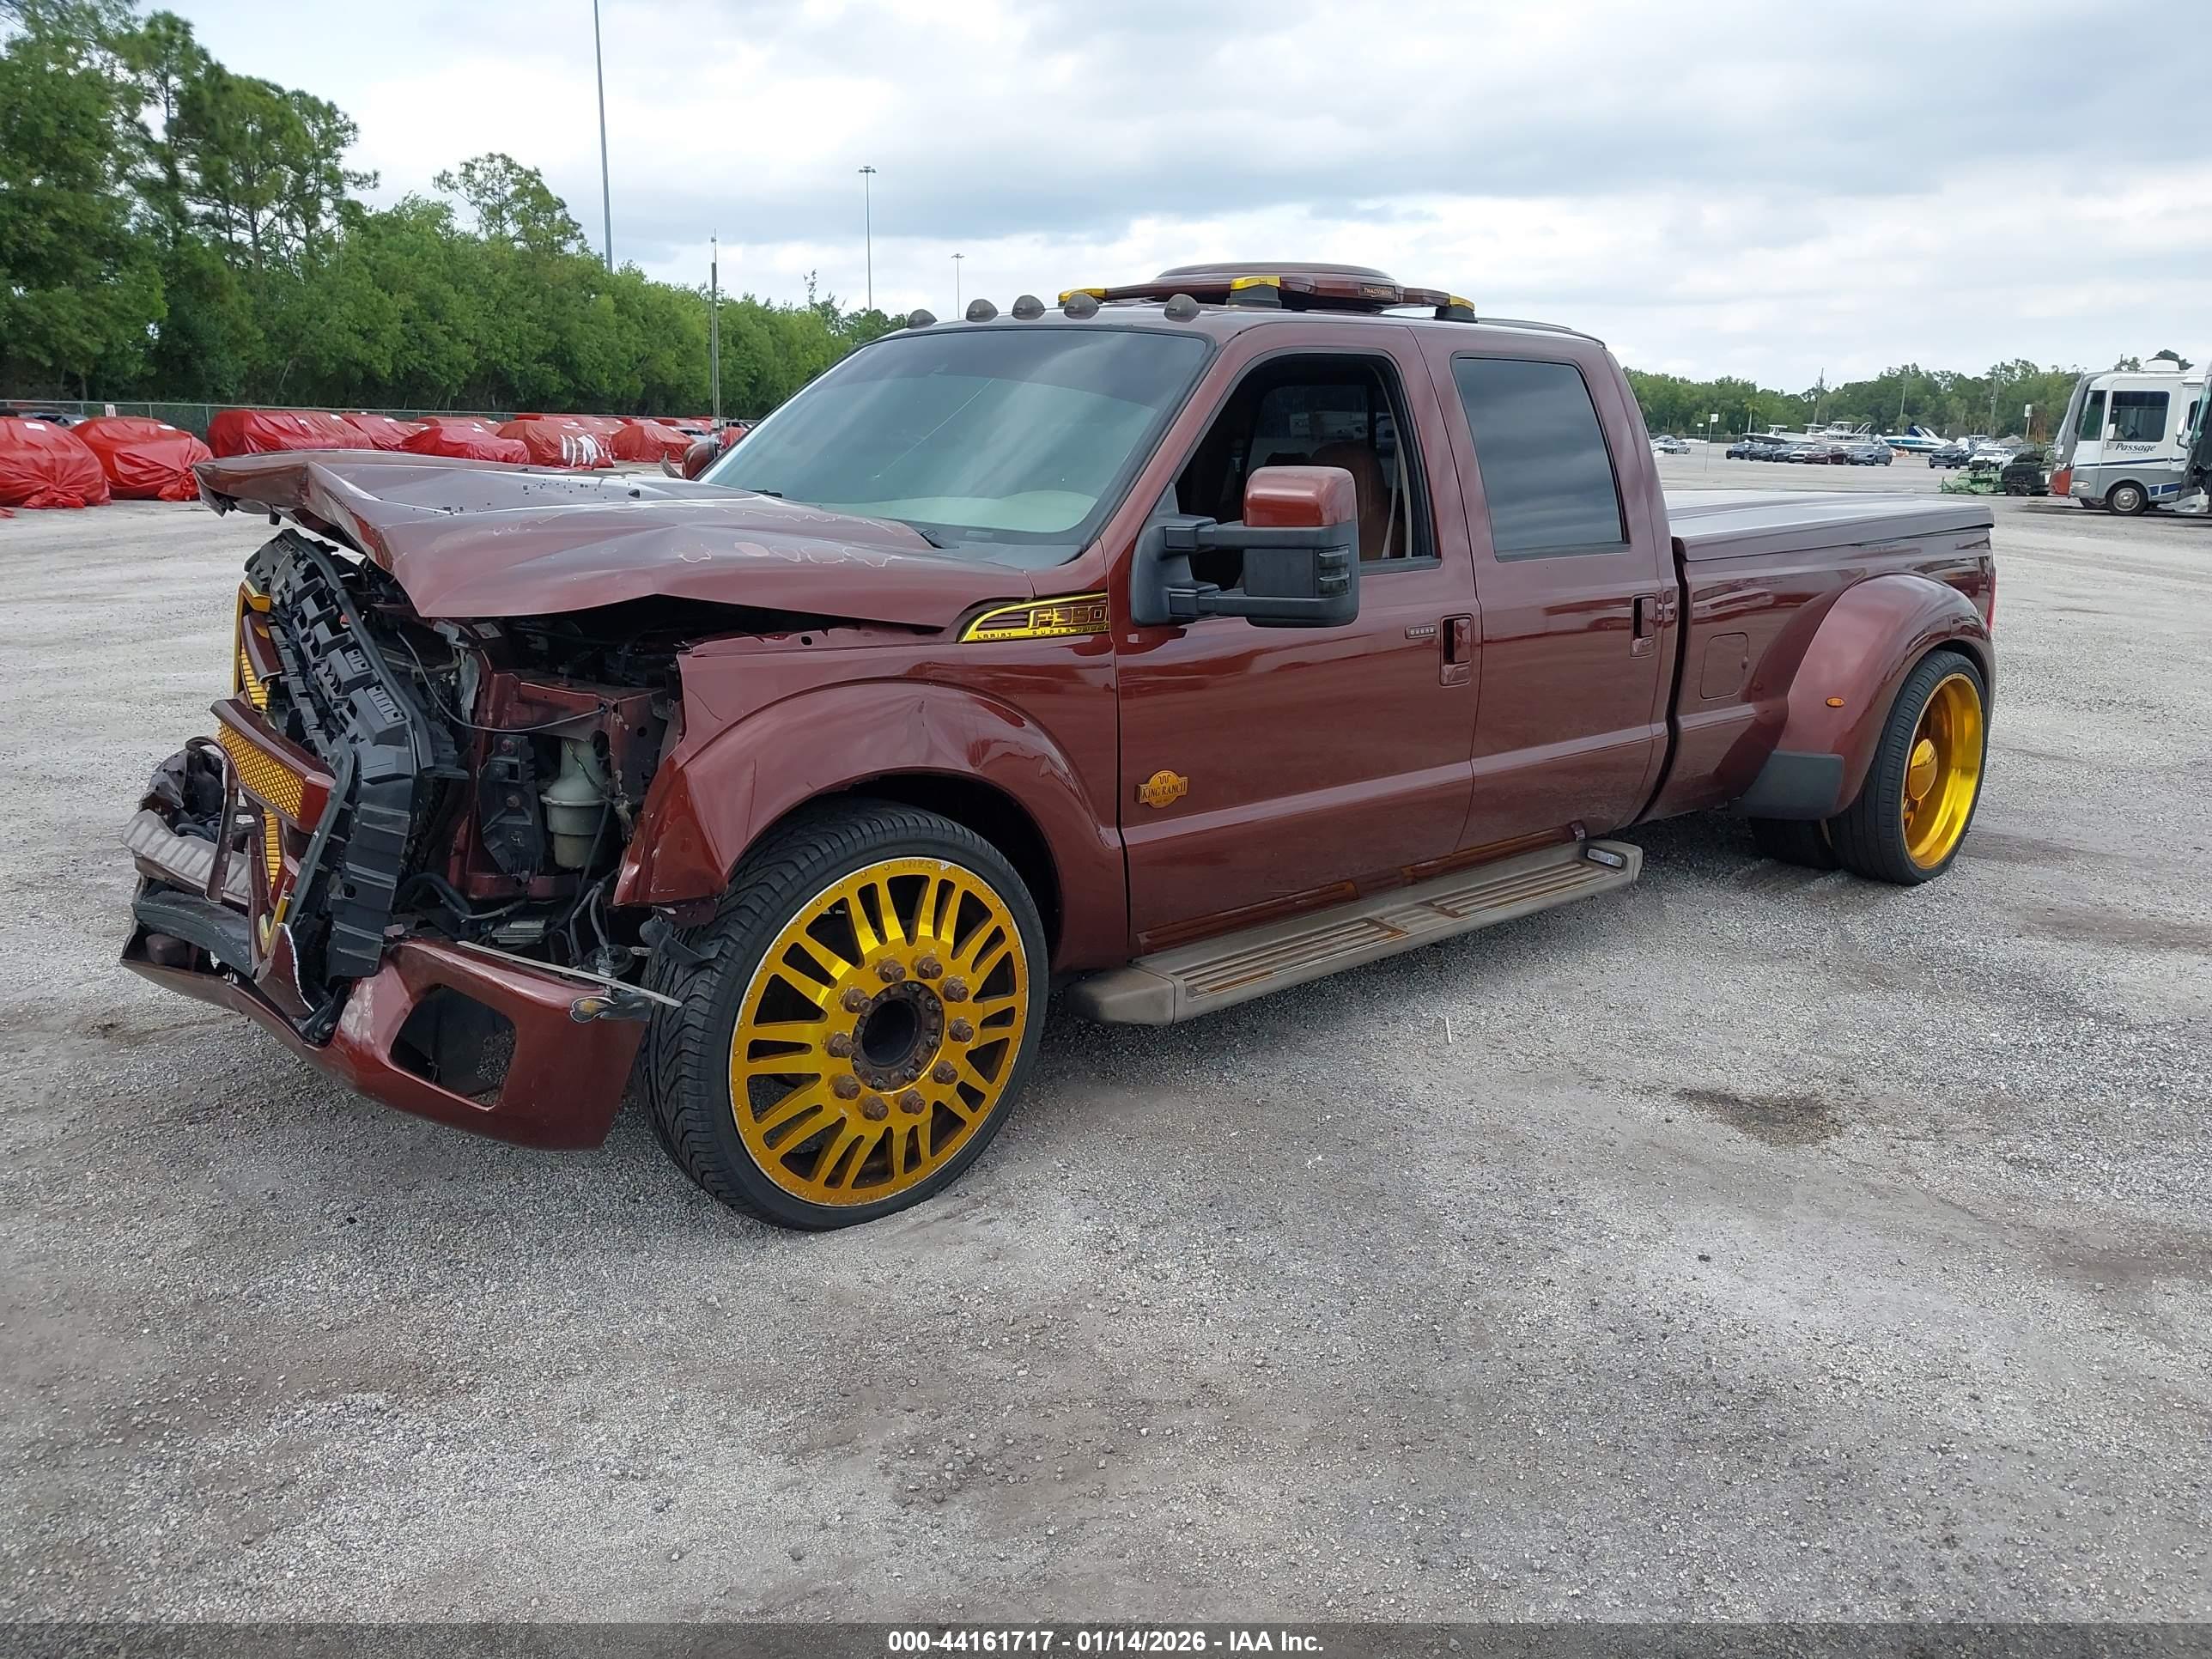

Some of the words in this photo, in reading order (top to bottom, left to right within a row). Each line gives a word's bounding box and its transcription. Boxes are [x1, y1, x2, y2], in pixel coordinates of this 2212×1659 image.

[2115, 442, 2156, 453] Passage
[1142, 787, 1161, 799] KING
[1162, 781, 1186, 795] RANCH
